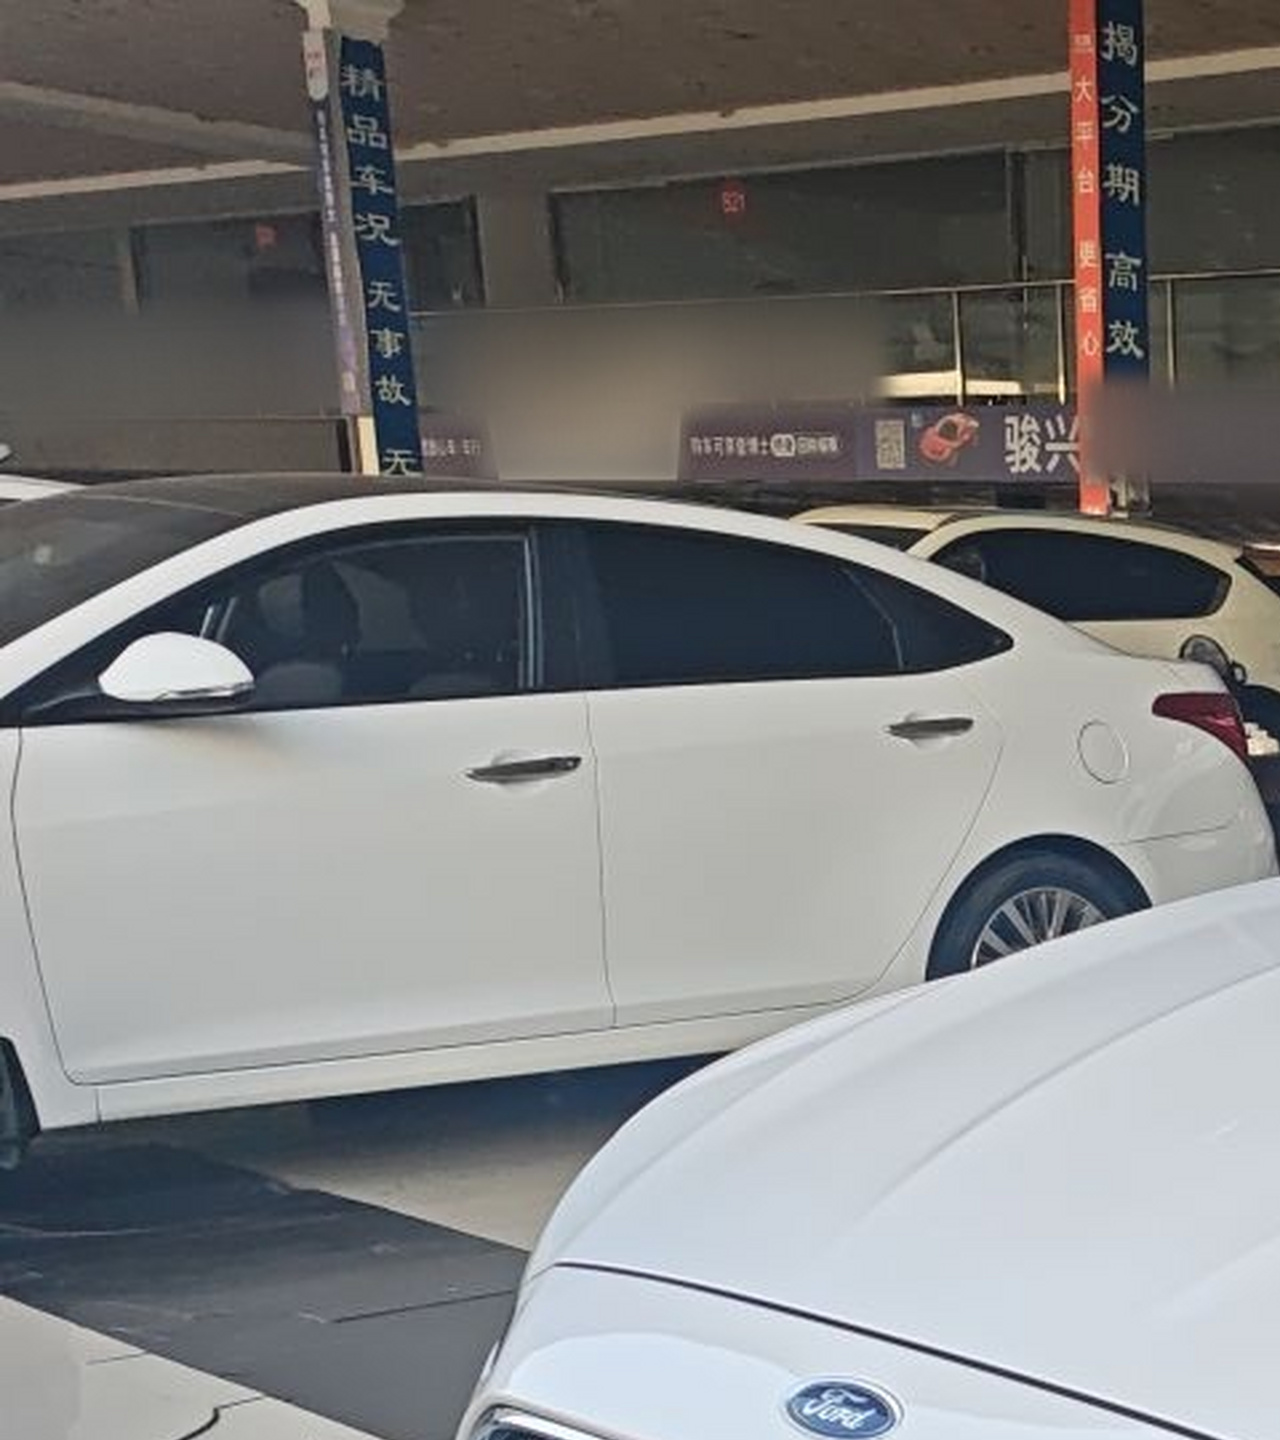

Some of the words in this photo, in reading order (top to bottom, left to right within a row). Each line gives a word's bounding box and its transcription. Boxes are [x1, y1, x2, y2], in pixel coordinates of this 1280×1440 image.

[341, 64, 400, 247] 精品车况
[368, 281, 412, 407] 无事故
[1104, 251, 1145, 359] 高效
[802, 1388, 876, 1430] Ford
